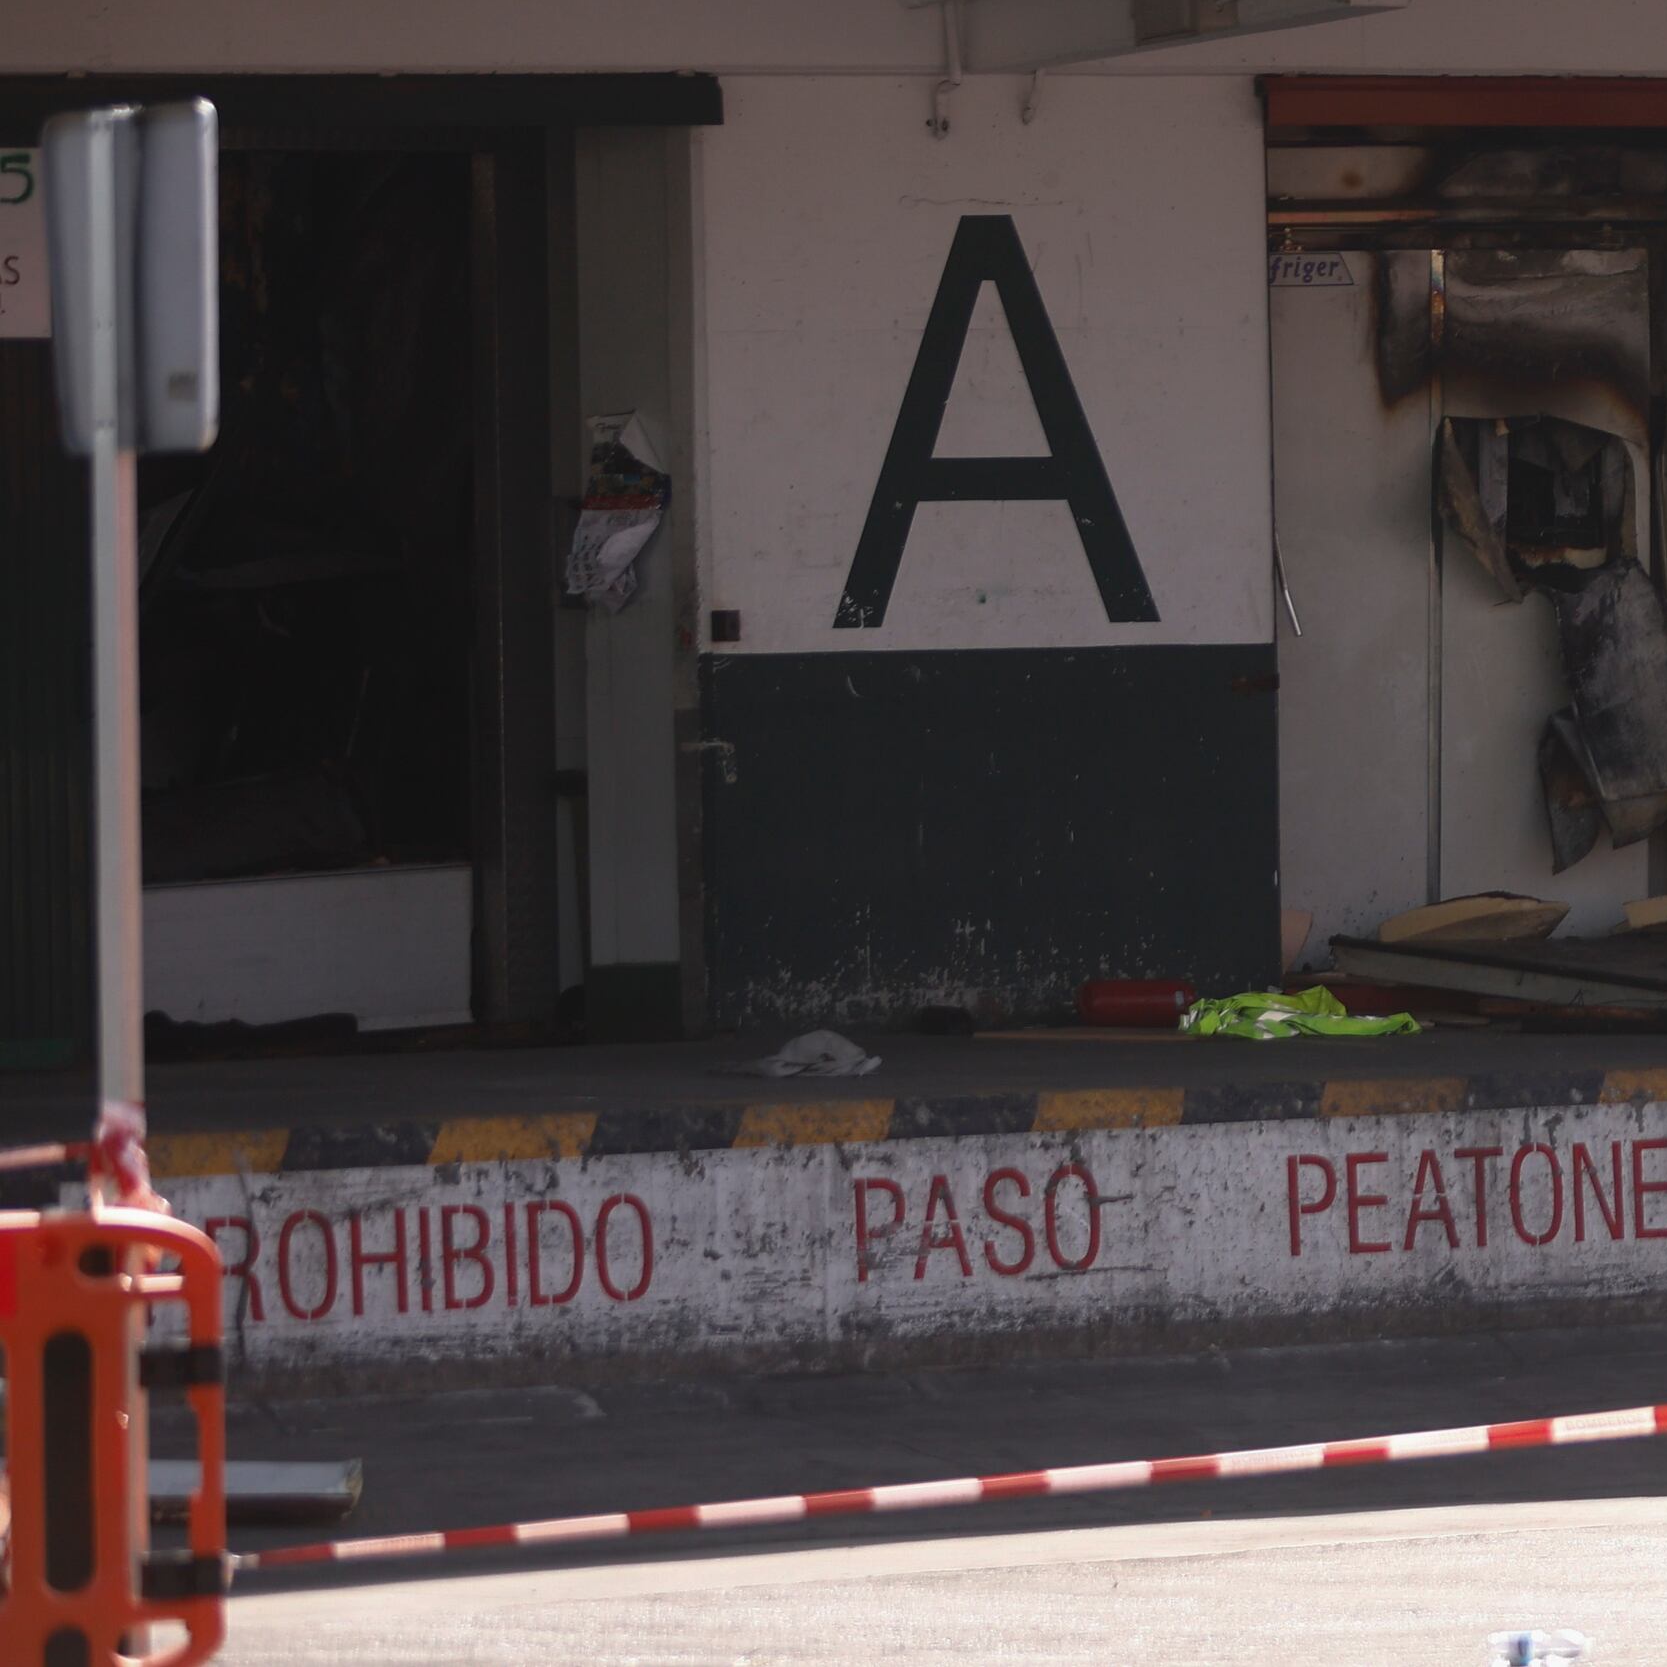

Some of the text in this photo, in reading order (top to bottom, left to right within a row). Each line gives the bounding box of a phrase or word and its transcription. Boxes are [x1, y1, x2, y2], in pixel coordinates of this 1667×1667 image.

[831, 214, 1162, 629] A
[204, 1192, 656, 1323] ROHIBIDO
[852, 1162, 1105, 1282] PASO
